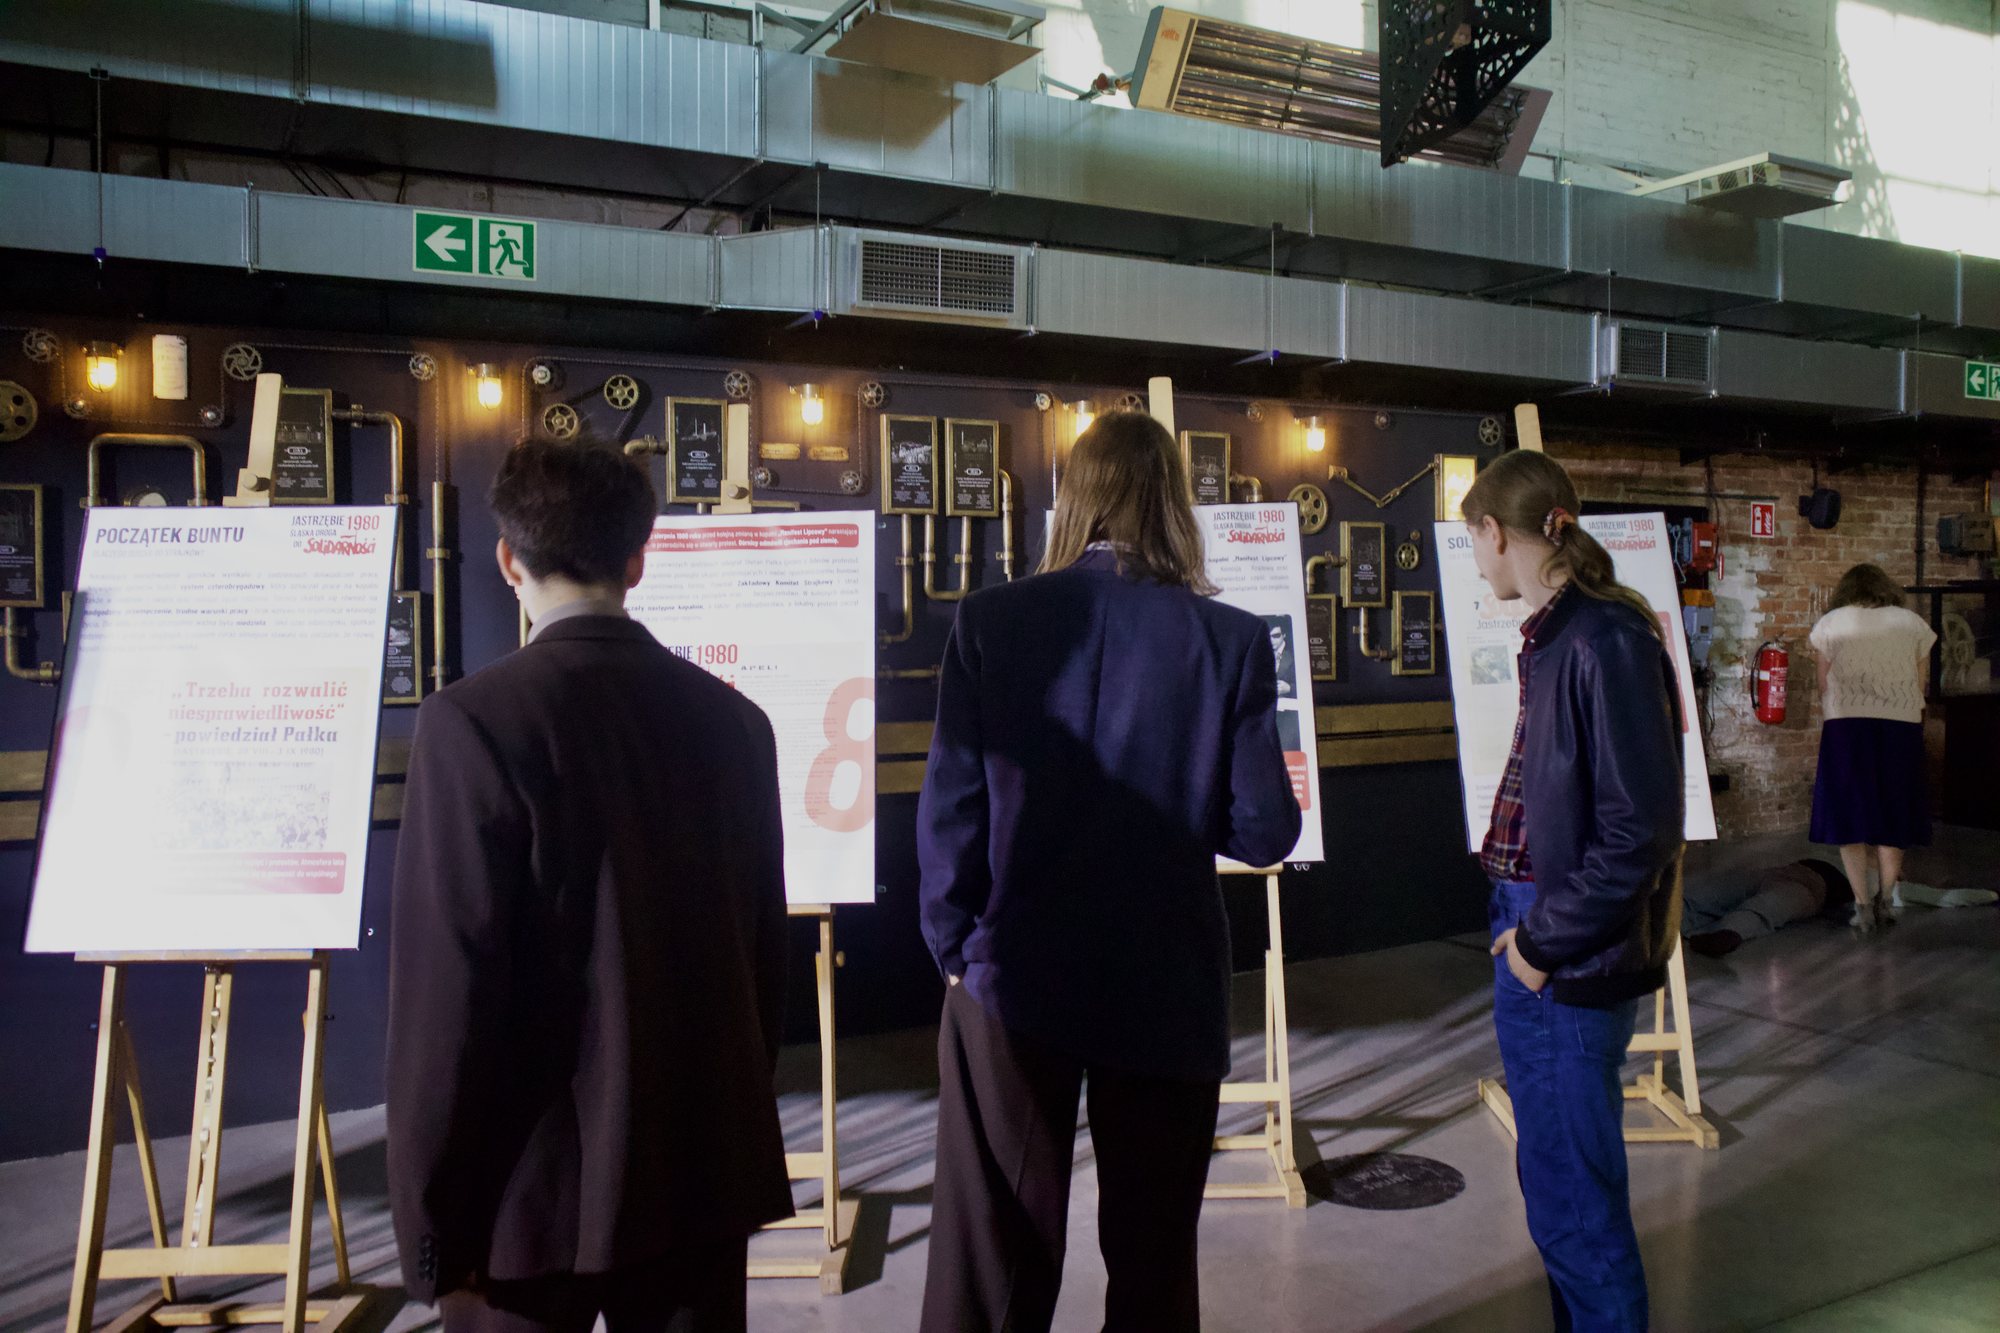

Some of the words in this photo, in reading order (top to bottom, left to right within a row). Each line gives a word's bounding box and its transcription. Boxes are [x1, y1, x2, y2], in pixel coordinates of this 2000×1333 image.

[291, 514, 345, 528] JASTRZĘBIE
[346, 515, 380, 530] 1980
[1213, 511, 1256, 521] JASTRZĘBIE
[1258, 510, 1285, 523] 1980
[1628, 519, 1655, 532] 1980
[96, 527, 183, 547] POCZĄTEK
[187, 526, 245, 543] BUNTU
[1447, 535, 1473, 550] SOL
[696, 643, 738, 665] 1980
[262, 681, 348, 698] rozwalić
[175, 726, 277, 744] powiedział
[283, 726, 338, 742] Pałka
[804, 676, 875, 833] 8
